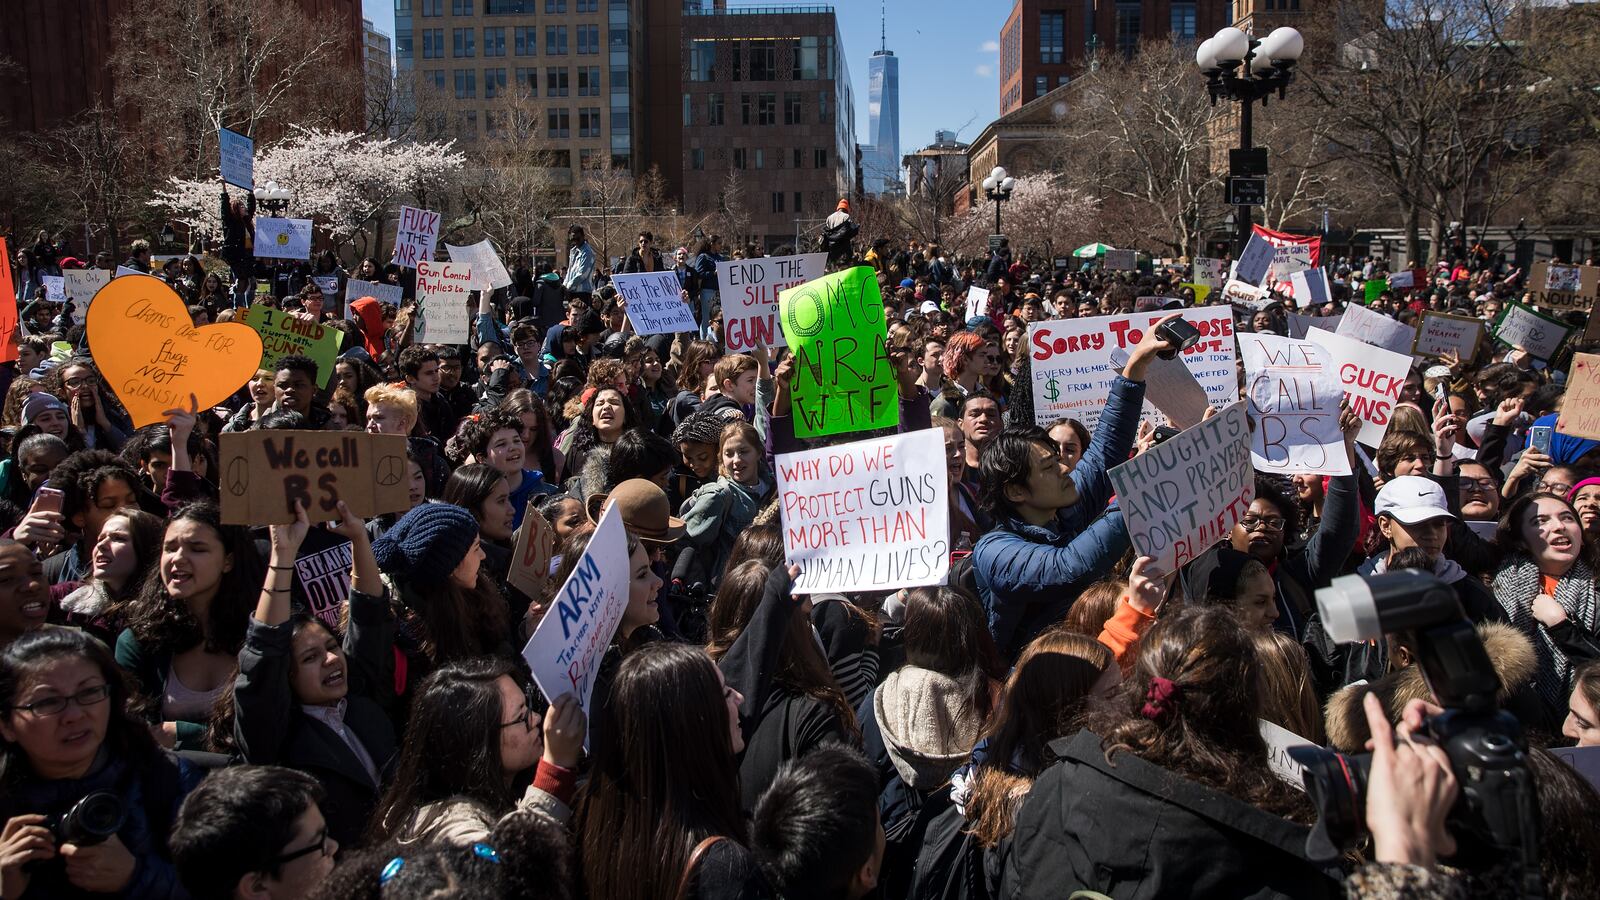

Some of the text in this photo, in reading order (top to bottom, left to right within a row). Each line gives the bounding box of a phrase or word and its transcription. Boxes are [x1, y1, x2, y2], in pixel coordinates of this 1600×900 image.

[403, 208, 438, 235] FUCK
[398, 243, 427, 265] NRA
[406, 232, 429, 245] THE
[68, 274, 81, 285] The
[417, 262, 440, 278] Gun
[443, 266, 471, 281] Control
[417, 278, 452, 295] Applies
[619, 275, 681, 300] Fuck the NRA
[730, 258, 803, 285] END THE
[631, 299, 682, 313] and the crew
[743, 281, 806, 306] SILE
[788, 274, 881, 337] OMG
[1530, 290, 1593, 308] ENOUGH
[263, 310, 325, 340] 1 CHILD
[269, 330, 291, 341] worth
[641, 314, 662, 332] they
[663, 316, 674, 325] run
[726, 314, 774, 350] GUN
[151, 339, 189, 372] Hugs
[205, 333, 235, 354] FOR
[263, 336, 304, 355] GUNS
[1254, 340, 1321, 365] WE
[135, 366, 184, 385] NOT
[793, 333, 897, 392] NRA
[1036, 369, 1072, 380] EVERY
[1076, 364, 1110, 375] MEMBE
[1043, 379, 1060, 402] $
[1067, 382, 1092, 392] FROM
[1194, 370, 1228, 378] WEETED
[1250, 375, 1323, 414] CALL
[1340, 363, 1404, 400] GUCK
[793, 385, 889, 432] WTF
[1344, 391, 1390, 425] UNS
[263, 436, 359, 470] We call
[780, 445, 894, 482] WHY DO WE
[1109, 409, 1240, 496] THOUGHTS
[284, 473, 339, 514] BS
[784, 473, 936, 521] PROTECT GUNS
[1128, 433, 1250, 529] AND PRAYERS
[1133, 463, 1249, 556] DON'T STOP
[789, 507, 926, 550] MORE THAN
[299, 544, 353, 580] STRAIGH
[524, 520, 549, 577] BS
[790, 540, 947, 588] HUMAN LIVES?
[557, 552, 601, 640] ARM
[557, 587, 604, 666] TEACHERS WITH
[568, 592, 615, 691] RESOURCES
